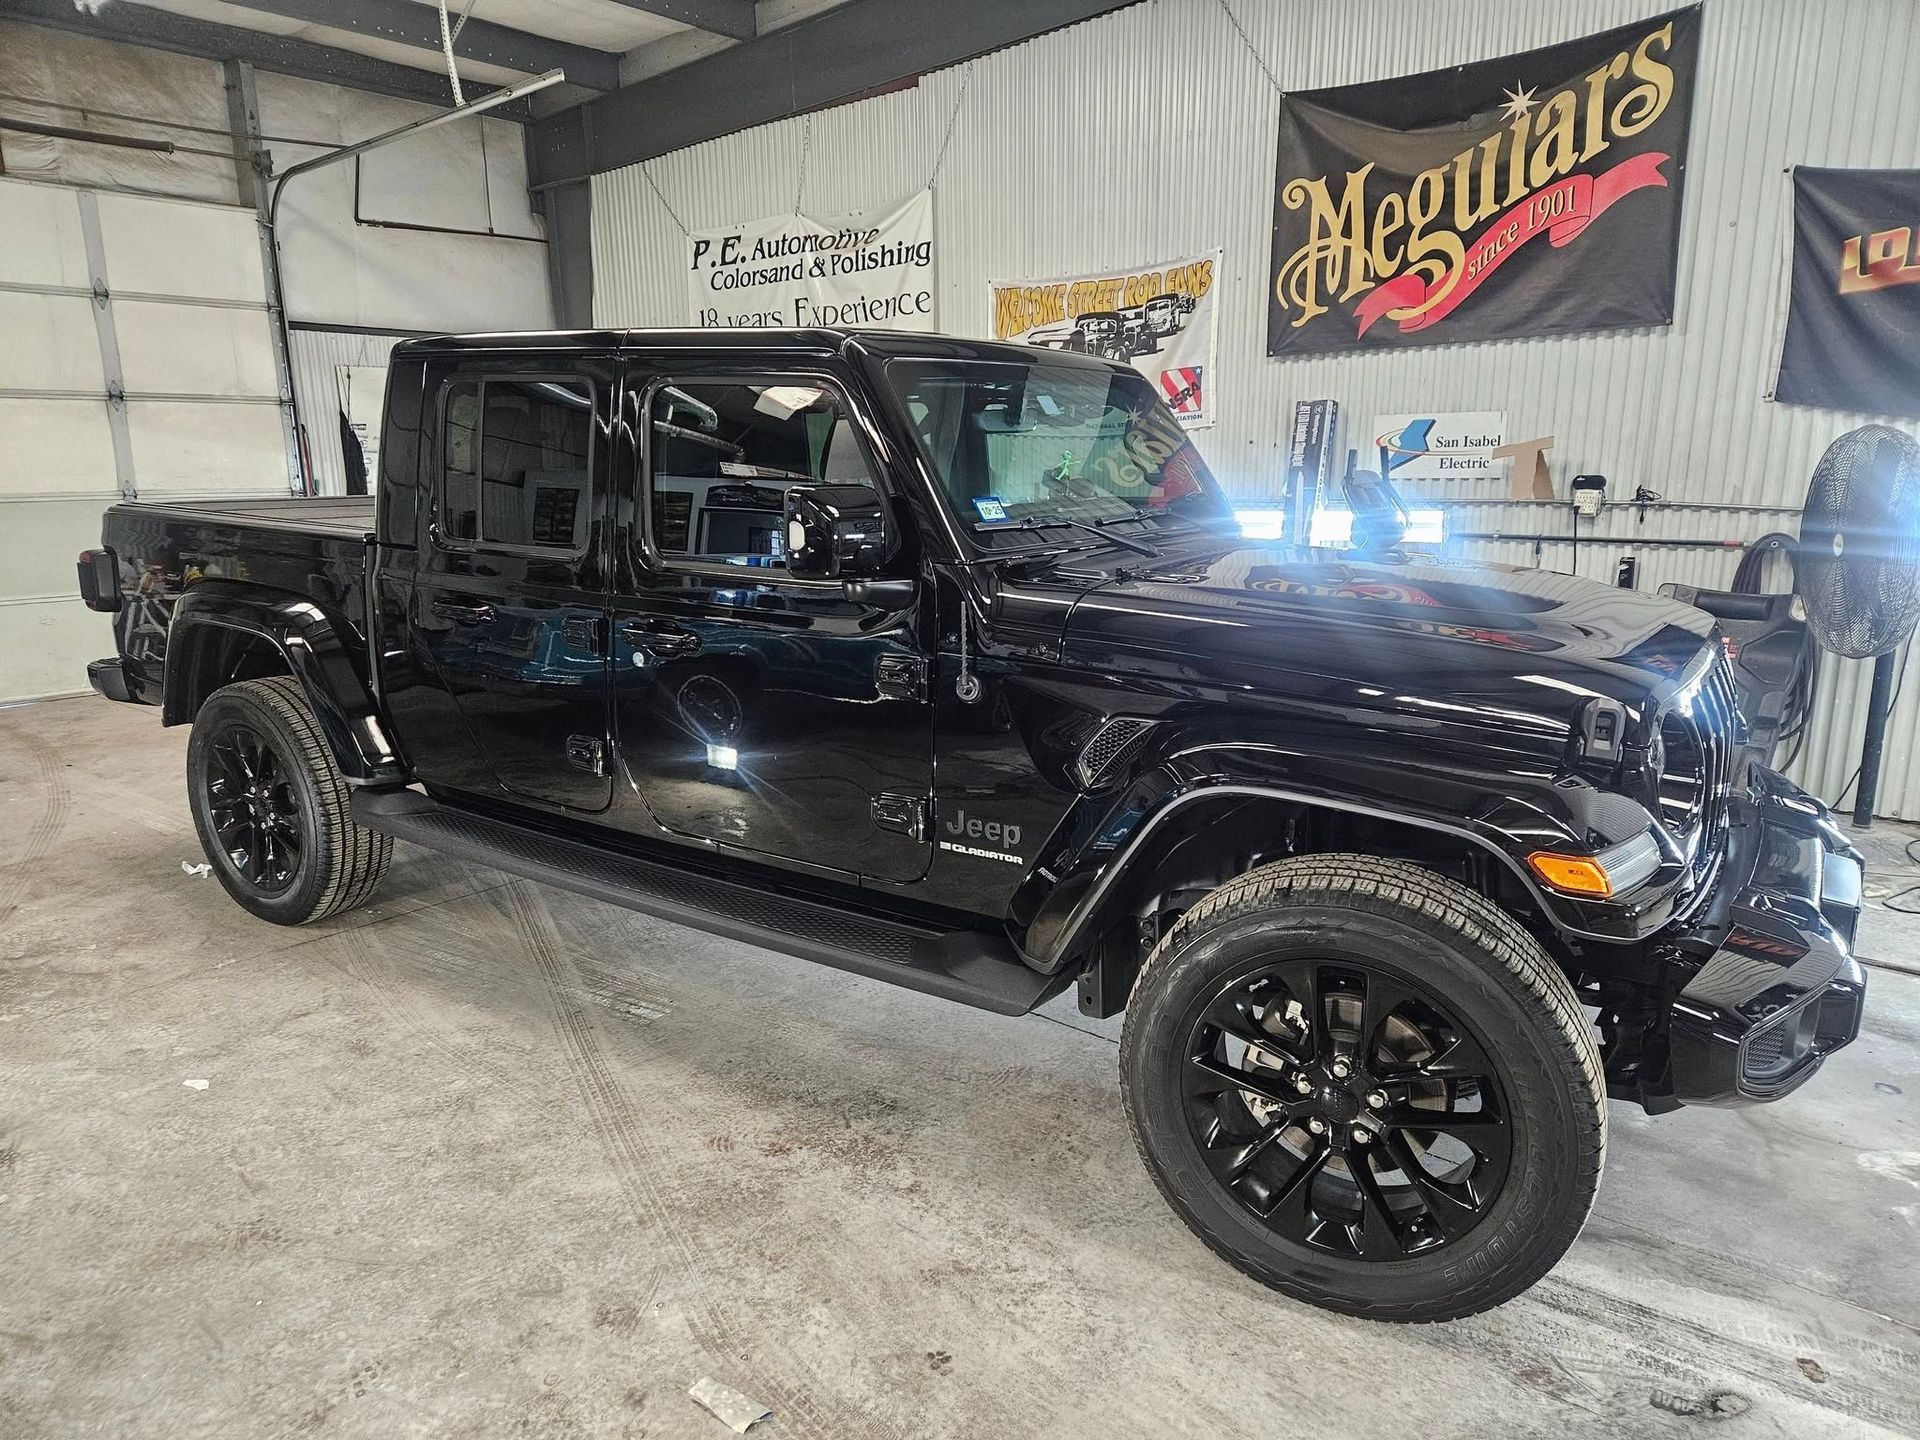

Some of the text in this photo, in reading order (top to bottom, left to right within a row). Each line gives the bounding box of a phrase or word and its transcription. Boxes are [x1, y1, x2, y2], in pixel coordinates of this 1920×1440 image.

[1276, 21, 1675, 327] Meguiars
[691, 228, 879, 270] P.E. Automotive
[1468, 185, 1577, 280] since 1901
[711, 240, 931, 291] Colorsand & Polishing
[1839, 226, 1920, 294] LO
[699, 289, 931, 327] 18 years Experience
[994, 260, 1213, 341] WELCOME STREET ROD FANS
[1435, 434, 1501, 448] San Isabel
[1439, 457, 1490, 470] Electric
[946, 809, 1022, 849] Jeep
[951, 843, 1024, 865] GLADIATOR
